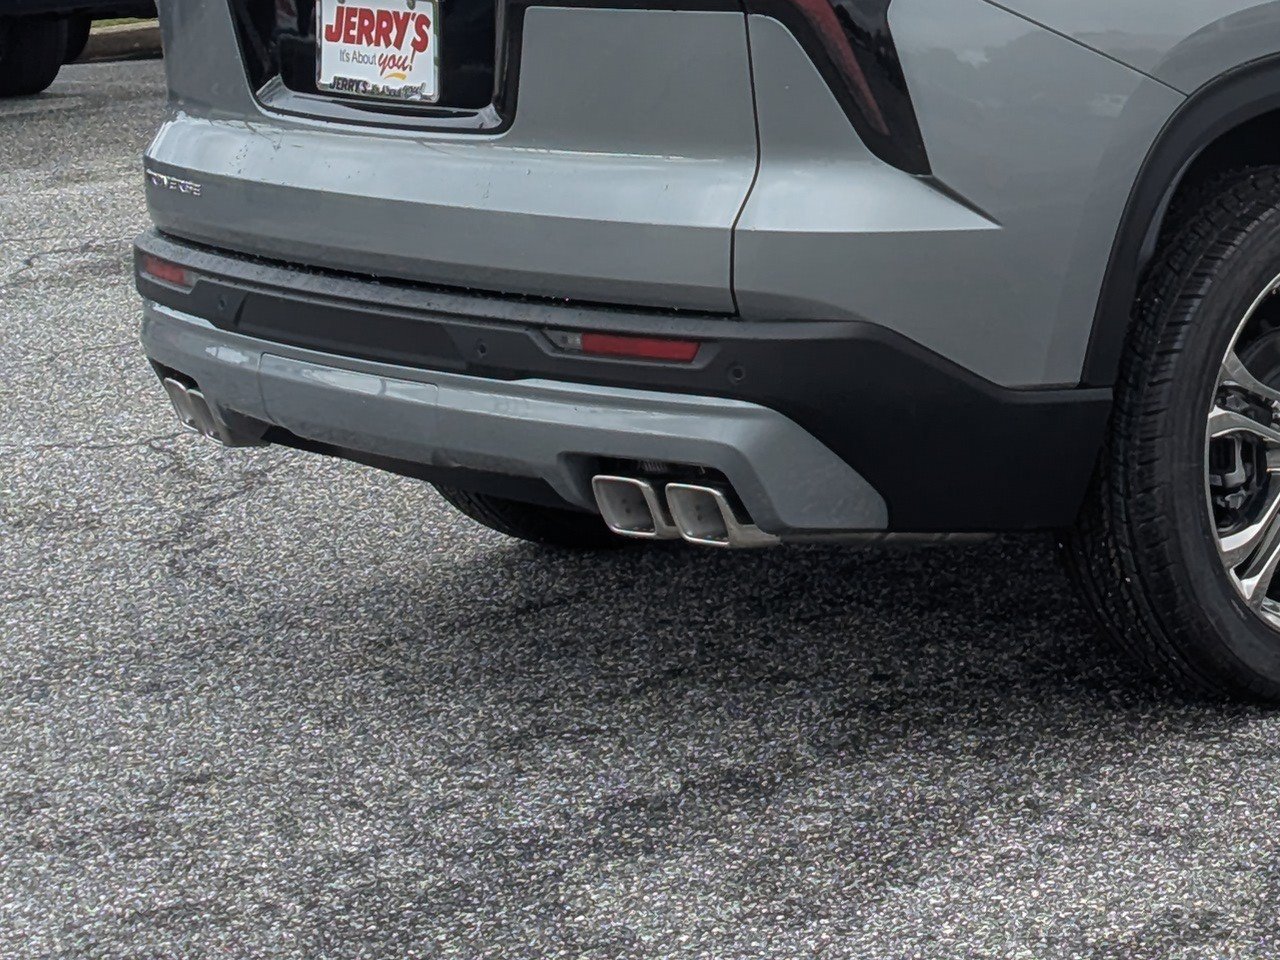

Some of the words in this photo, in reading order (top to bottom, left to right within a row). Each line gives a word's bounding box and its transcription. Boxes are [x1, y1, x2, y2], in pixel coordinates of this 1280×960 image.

[325, 6, 431, 53] JERRY'S
[339, 49, 350, 62] It's
[352, 50, 377, 65] About
[377, 47, 416, 76] you!
